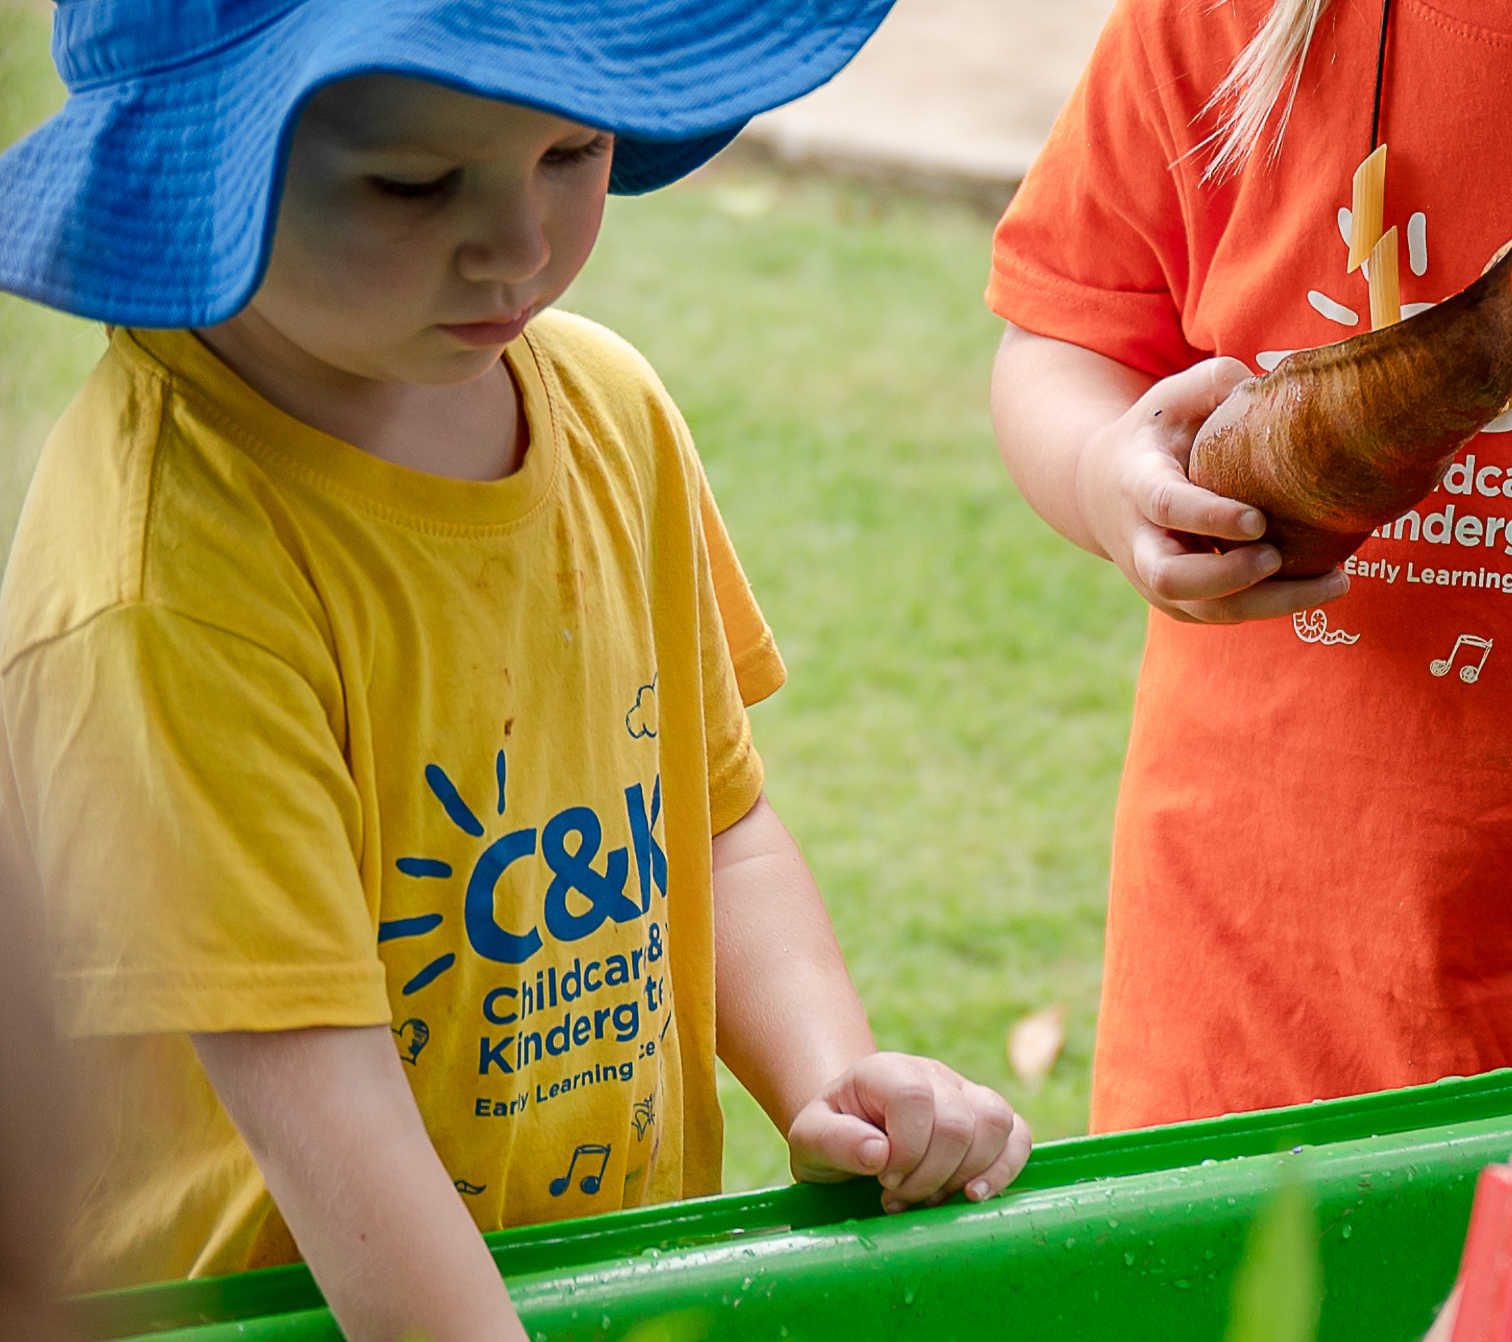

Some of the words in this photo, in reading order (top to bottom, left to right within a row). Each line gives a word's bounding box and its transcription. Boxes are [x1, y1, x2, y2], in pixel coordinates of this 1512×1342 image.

[1344, 554, 1400, 584] Early
[464, 773, 668, 963] C&K
[483, 947, 647, 1025] Childcar
[475, 1092, 529, 1118] Early
[536, 1061, 633, 1104] Learning
